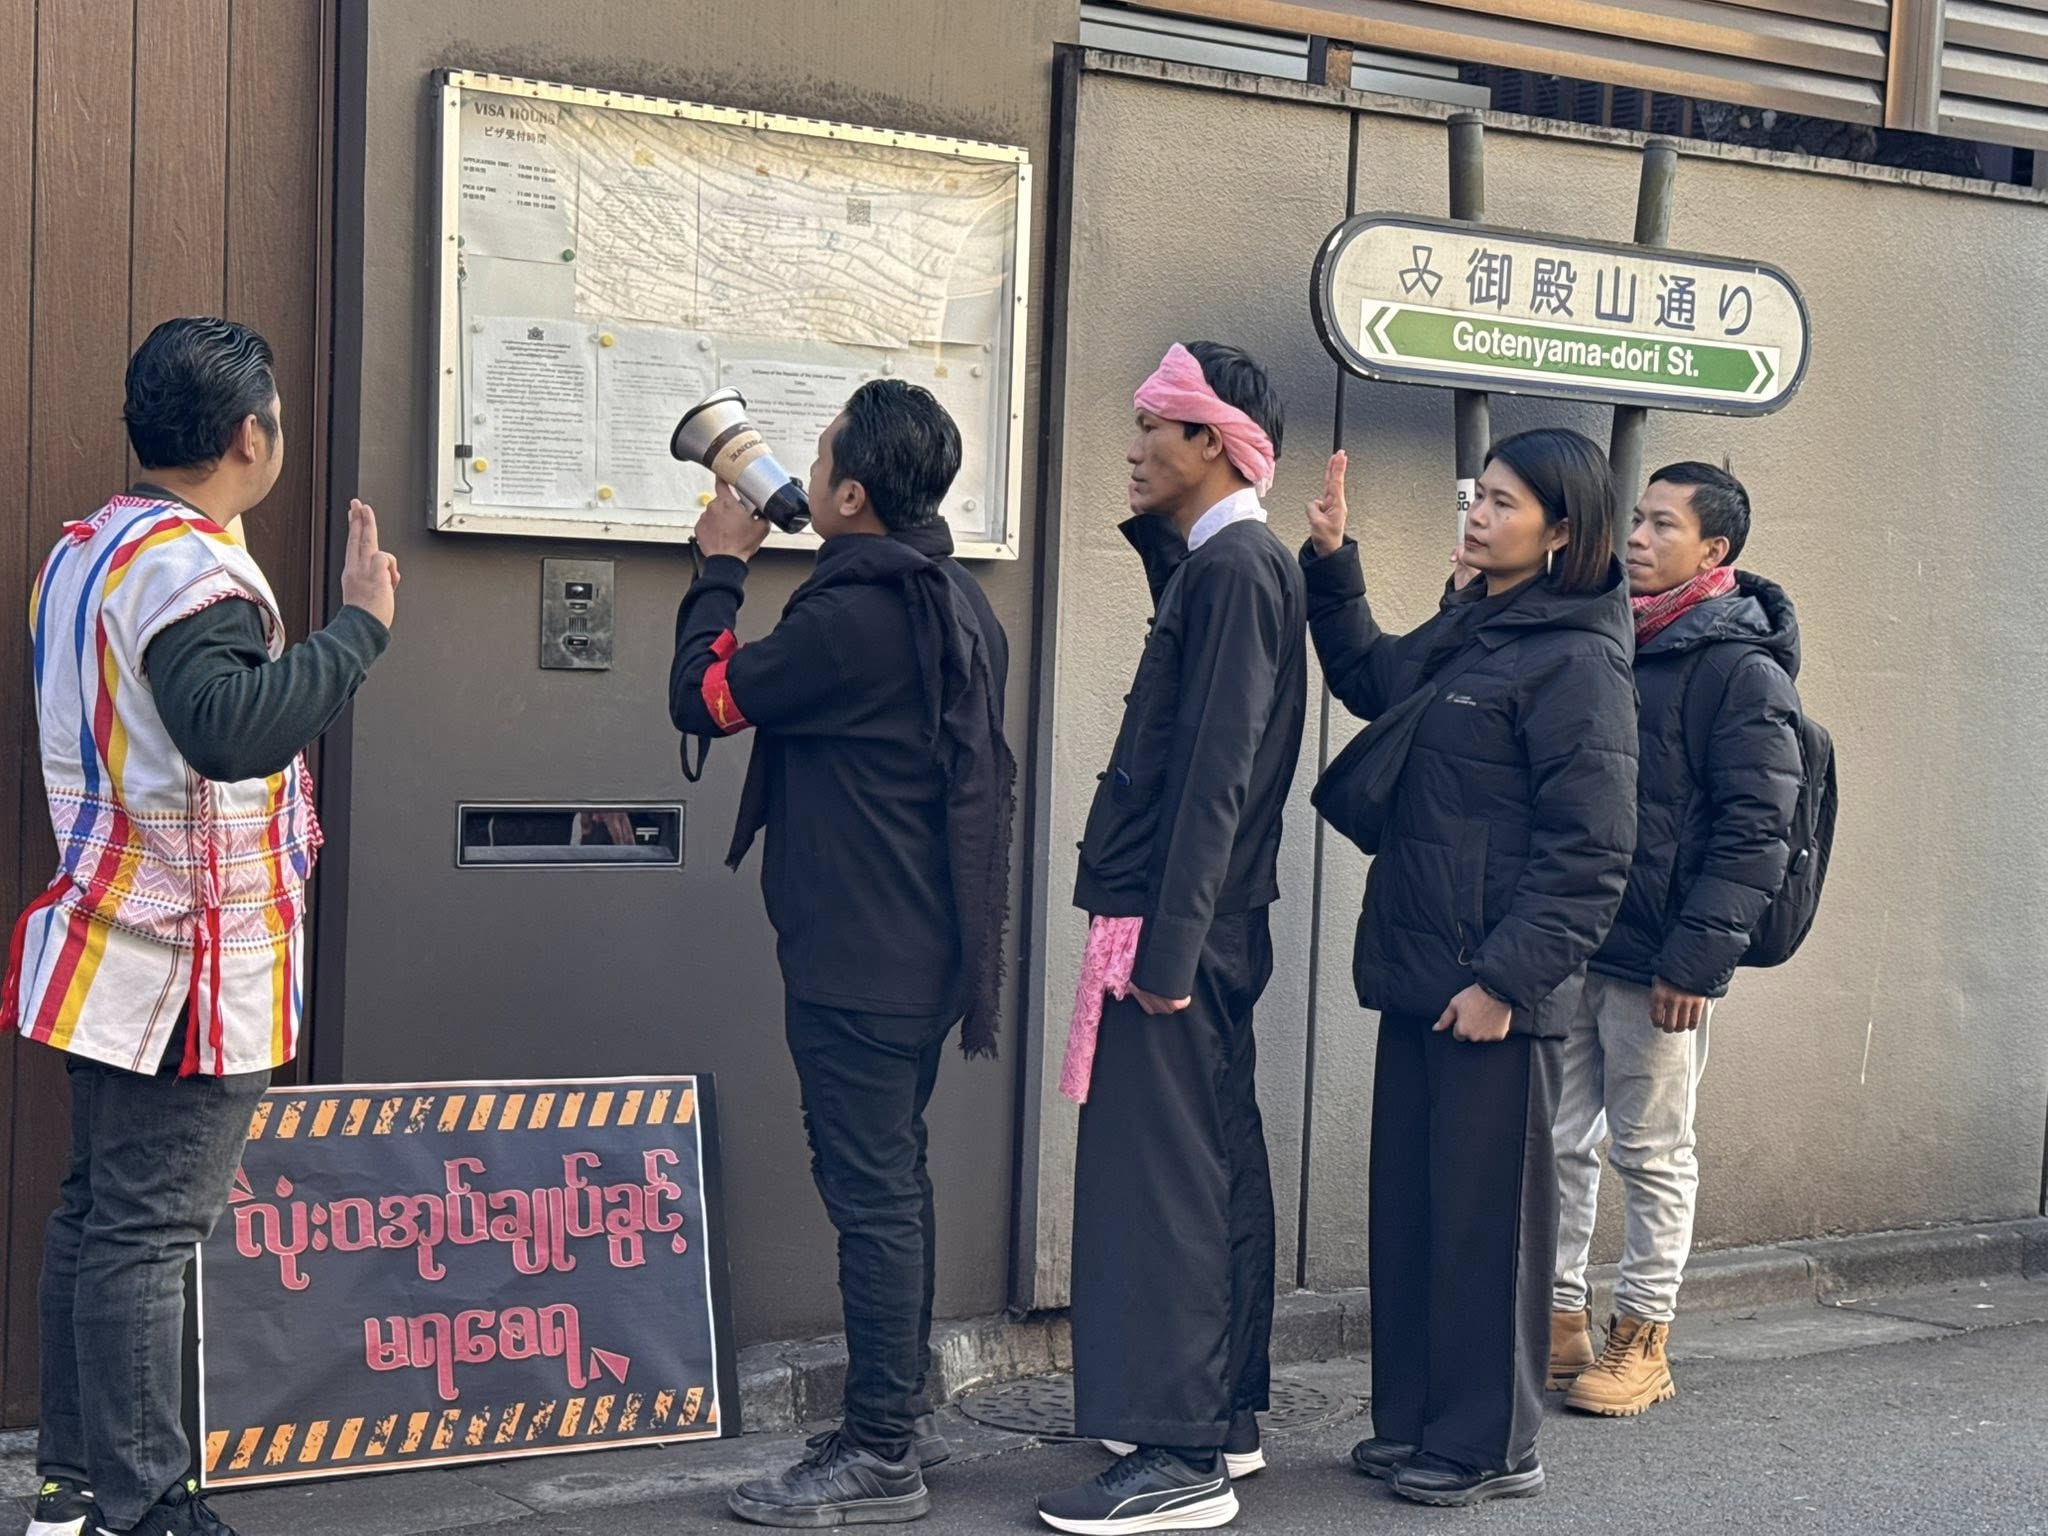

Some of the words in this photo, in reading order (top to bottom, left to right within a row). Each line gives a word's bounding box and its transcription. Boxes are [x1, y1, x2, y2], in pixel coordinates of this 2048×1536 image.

[474, 101, 505, 118] VISA
[1465, 247, 1753, 336] 御殿山通り
[1452, 320, 1660, 374] Gotenyama-dori
[1668, 348, 1701, 377] St.
